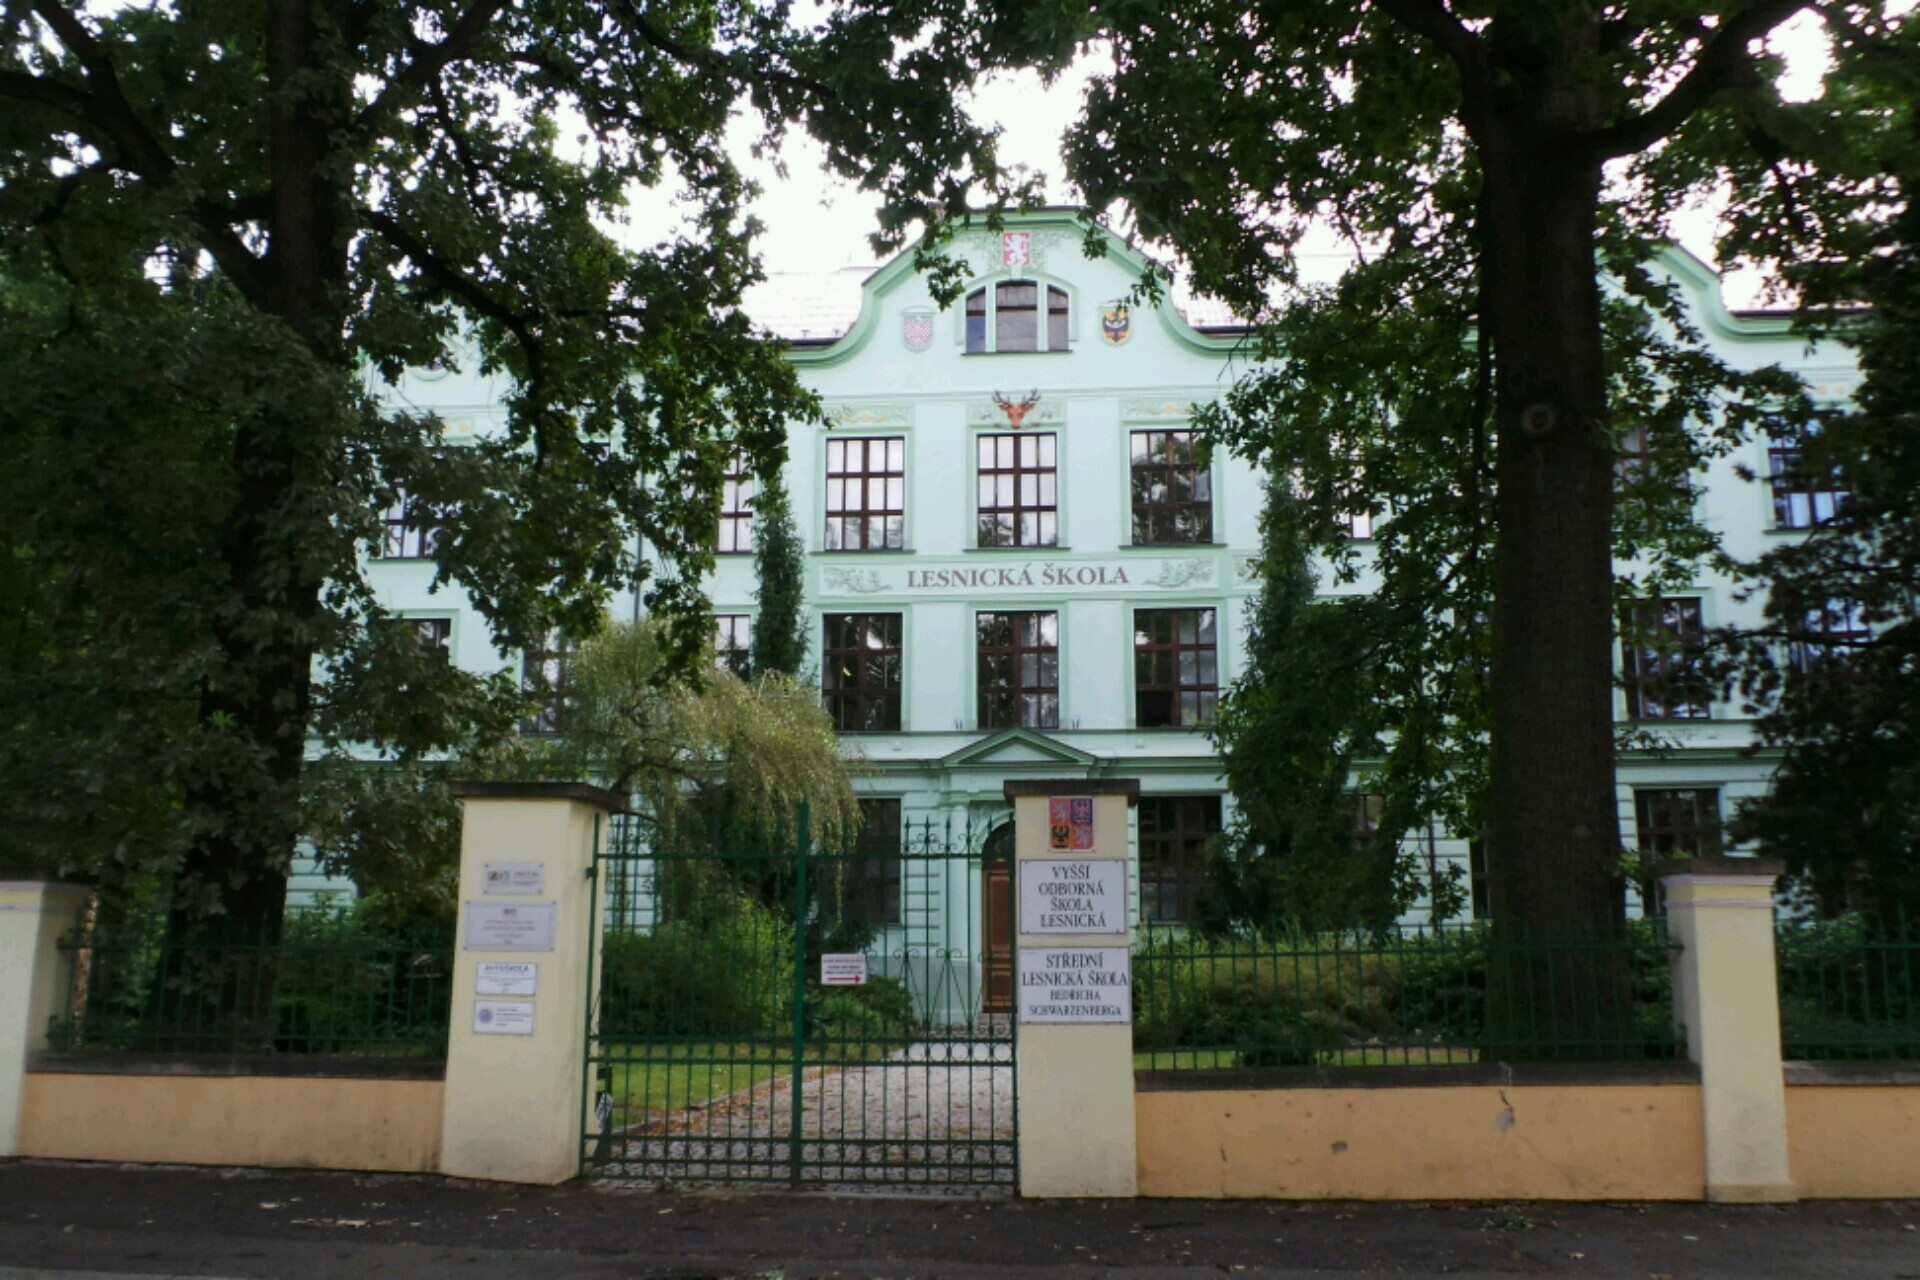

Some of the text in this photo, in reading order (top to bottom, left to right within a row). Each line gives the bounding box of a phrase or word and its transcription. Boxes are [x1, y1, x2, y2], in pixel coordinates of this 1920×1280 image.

[907, 562, 1129, 588] LESNICKÁ ŠKOLA
[1052, 863, 1091, 880] VYŠŠÍ
[1038, 880, 1105, 896] ODBORNÁ
[1050, 896, 1093, 912] ŠKOLA
[1040, 911, 1107, 928] LESNICKÁ
[1045, 952, 1104, 969] STŘEDNÍ
[1022, 969, 1129, 987] LESNICKÁ ŠKOLA
[1029, 1004, 1122, 1017] SCHWARZENBERGA
